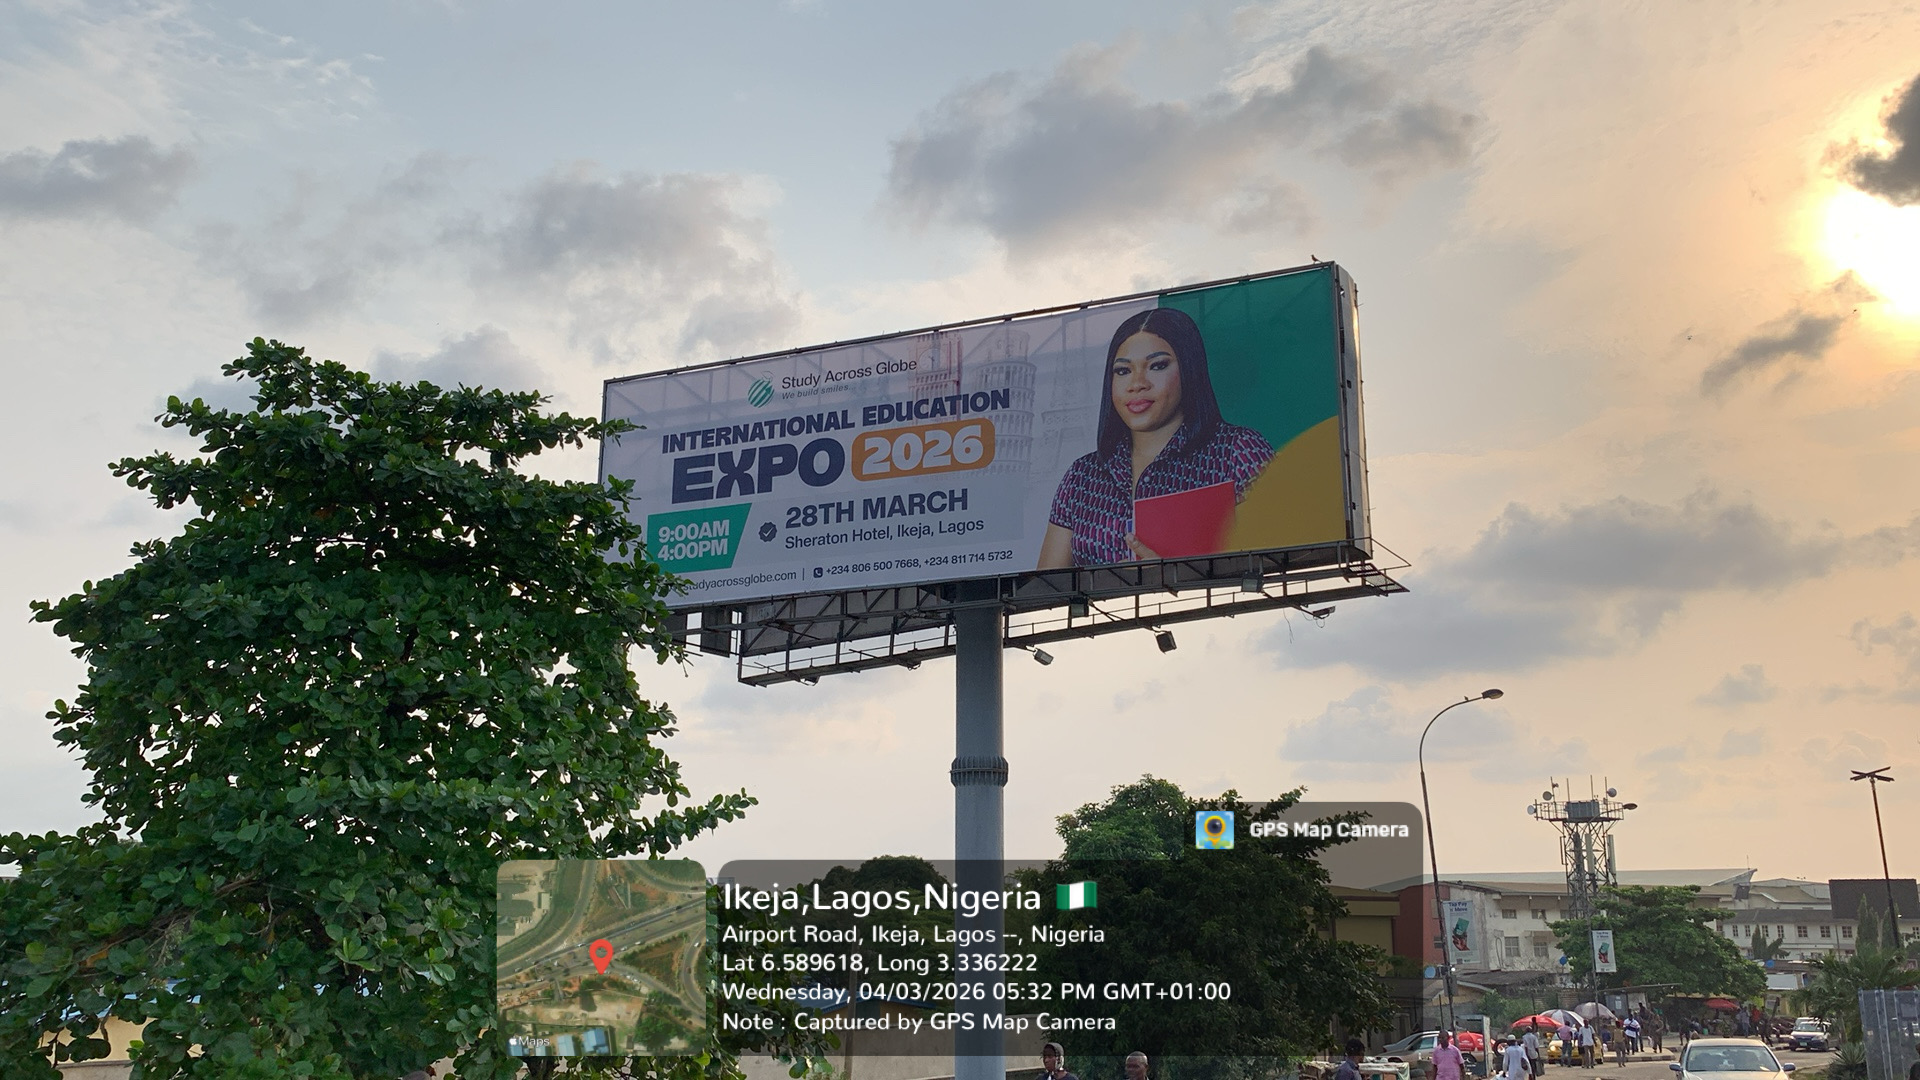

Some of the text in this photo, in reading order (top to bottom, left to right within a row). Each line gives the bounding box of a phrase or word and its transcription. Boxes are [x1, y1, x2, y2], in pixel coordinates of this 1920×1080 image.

[781, 359, 917, 389] Study Across Globe
[782, 392, 795, 400] We
[797, 387, 819, 398] build
[662, 388, 1010, 454] INTERNATIONAL EDUCATION
[671, 424, 984, 504] EXPO 2026
[785, 488, 968, 529] 28TH MARCH
[658, 519, 730, 543] 9:00AM
[785, 519, 985, 549] Sheraton Hotel, Ikeja, Lagos
[657, 538, 728, 562] 4:00PM
[826, 550, 1013, 575] +234 806 500 7668, +234 811 714 5732
